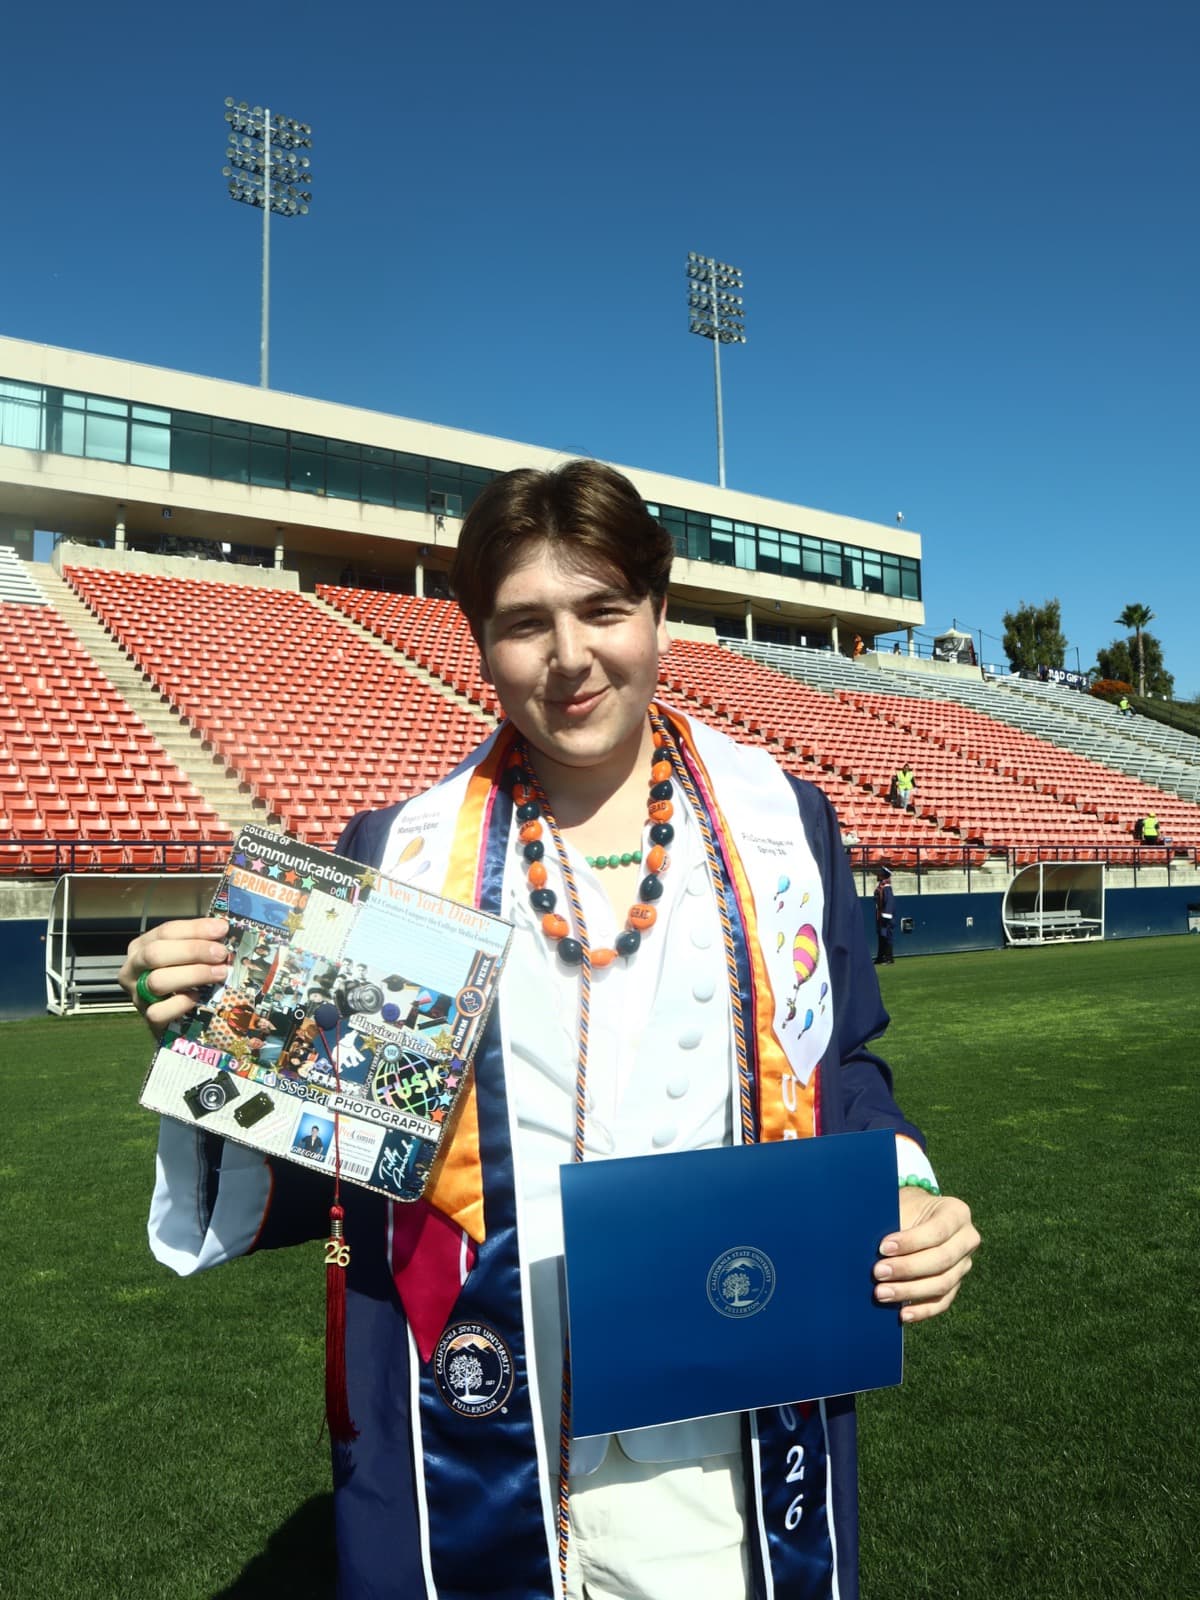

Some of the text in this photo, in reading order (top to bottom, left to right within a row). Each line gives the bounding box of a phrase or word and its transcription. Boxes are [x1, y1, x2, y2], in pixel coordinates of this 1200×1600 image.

[243, 825, 291, 847] COLLEGE OF
[238, 836, 361, 888] Communications
[233, 870, 309, 909] SPRING 2026
[388, 880, 412, 904] New
[416, 889, 444, 916] York
[453, 958, 491, 1049] COMM WEEK
[280, 1079, 328, 1106] Press
[376, 1064, 443, 1106] TUSK
[334, 1096, 436, 1137] PHOTOGRAPHY
[324, 1240, 350, 1267] 26
[436, 1325, 511, 1375] CALIFORNIA STATE UNIVERSITY
[451, 1398, 498, 1414] FULLERTON
